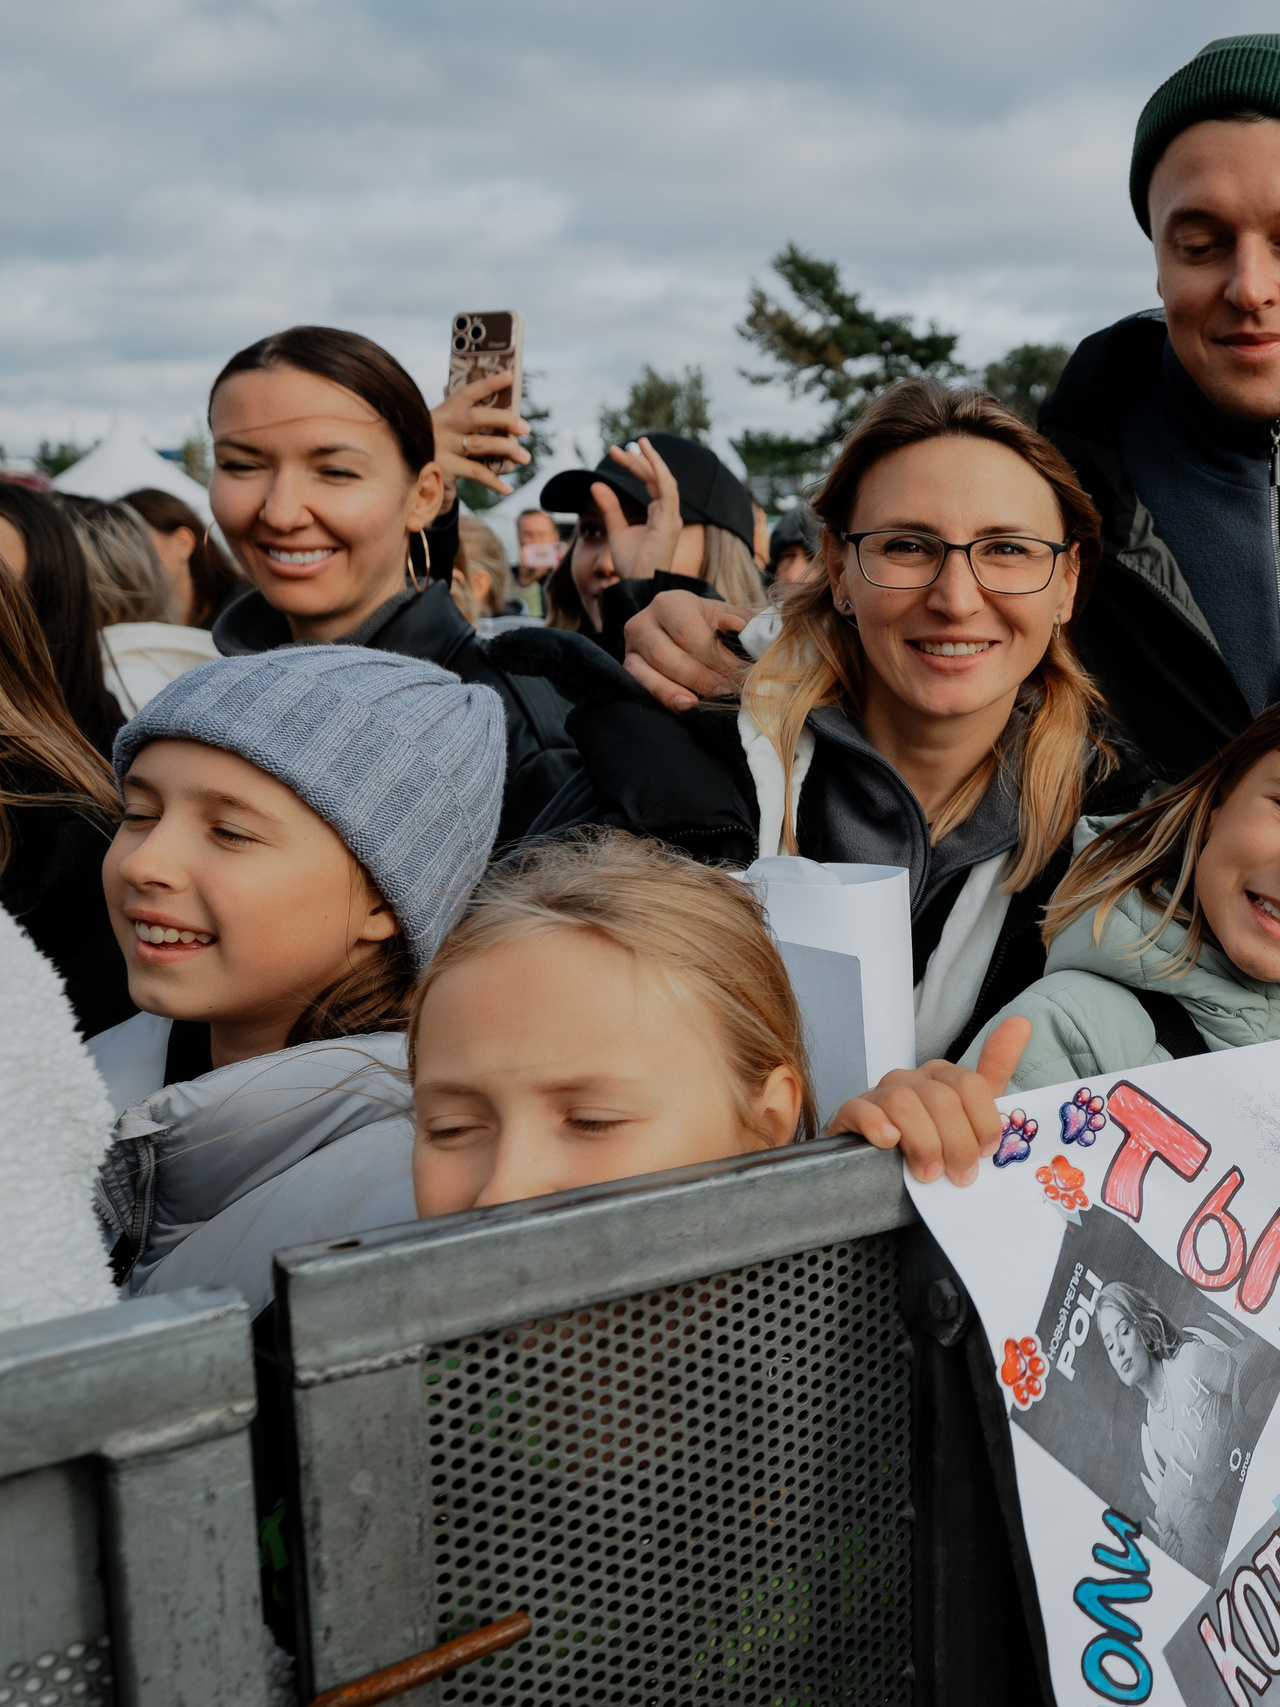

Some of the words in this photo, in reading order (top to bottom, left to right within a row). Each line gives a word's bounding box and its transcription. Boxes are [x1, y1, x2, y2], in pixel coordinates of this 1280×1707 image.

[1047, 1307, 1070, 1360] НОВЫЙ
[1062, 1262, 1085, 1310] РЕЛИЗ
[1056, 1268, 1104, 1382] POLI
[1239, 1451, 1251, 1483] LOTUS
[1073, 1507, 1153, 1706] ОЛИ
